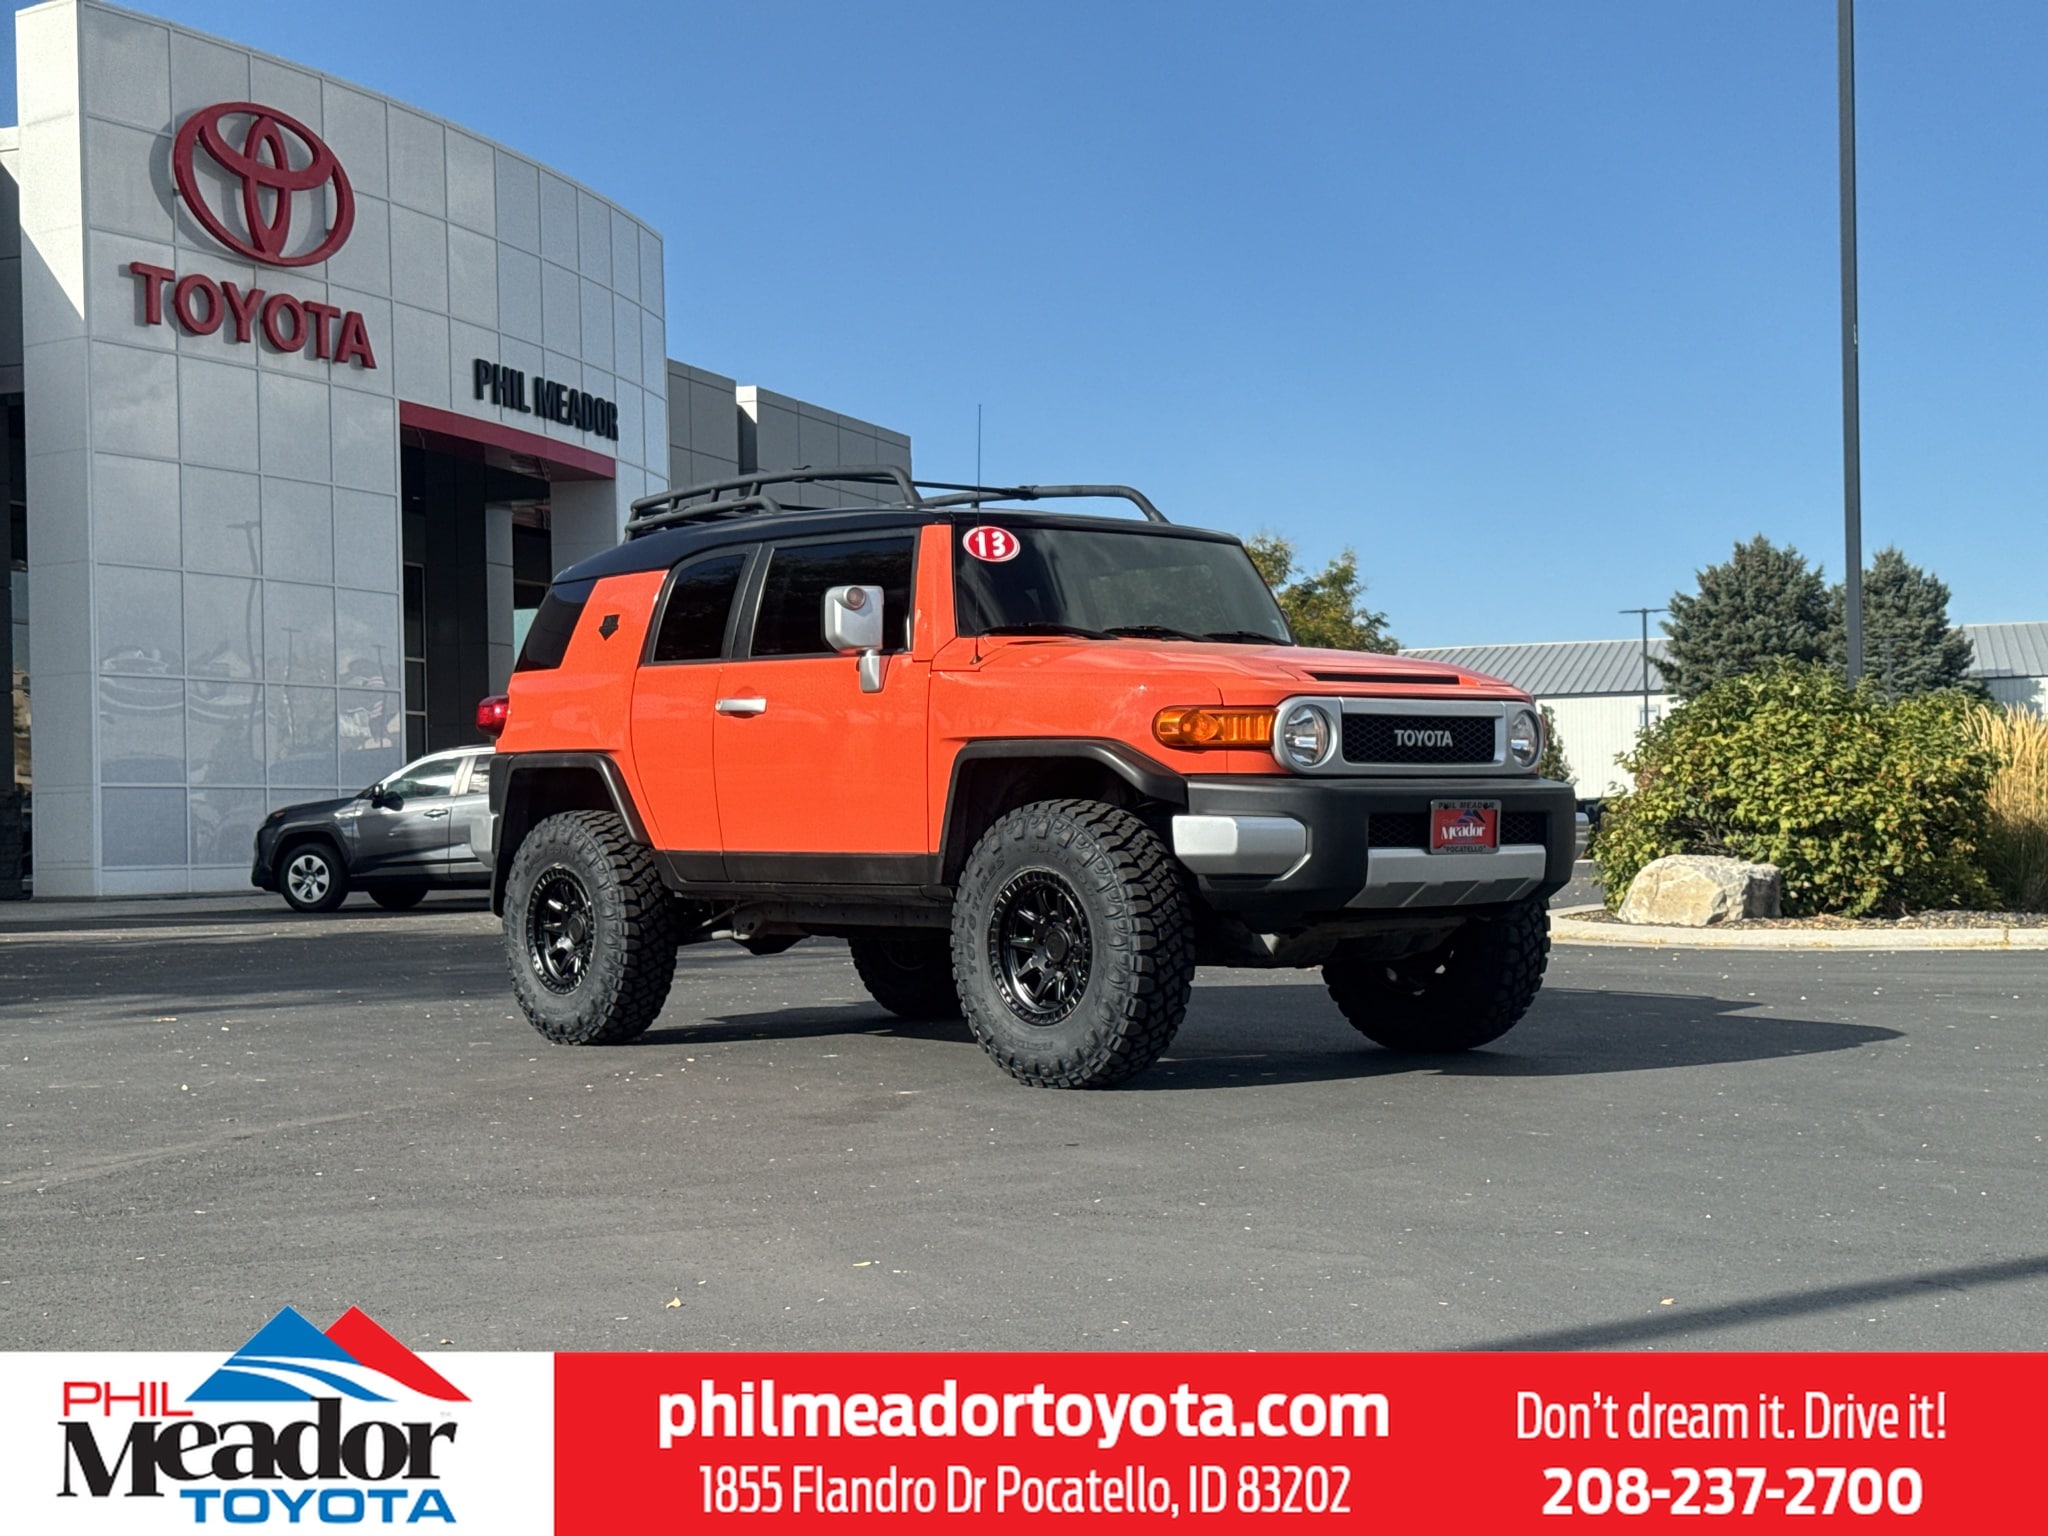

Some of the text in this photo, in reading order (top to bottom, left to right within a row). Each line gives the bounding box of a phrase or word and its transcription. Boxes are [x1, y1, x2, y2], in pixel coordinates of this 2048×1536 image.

[129, 261, 377, 369] TOYOTA
[473, 358, 619, 441] PHIL MEADOR
[975, 531, 1006, 557] 13
[1394, 729, 1453, 747] TOYOTA
[1441, 822, 1486, 840] Meador
